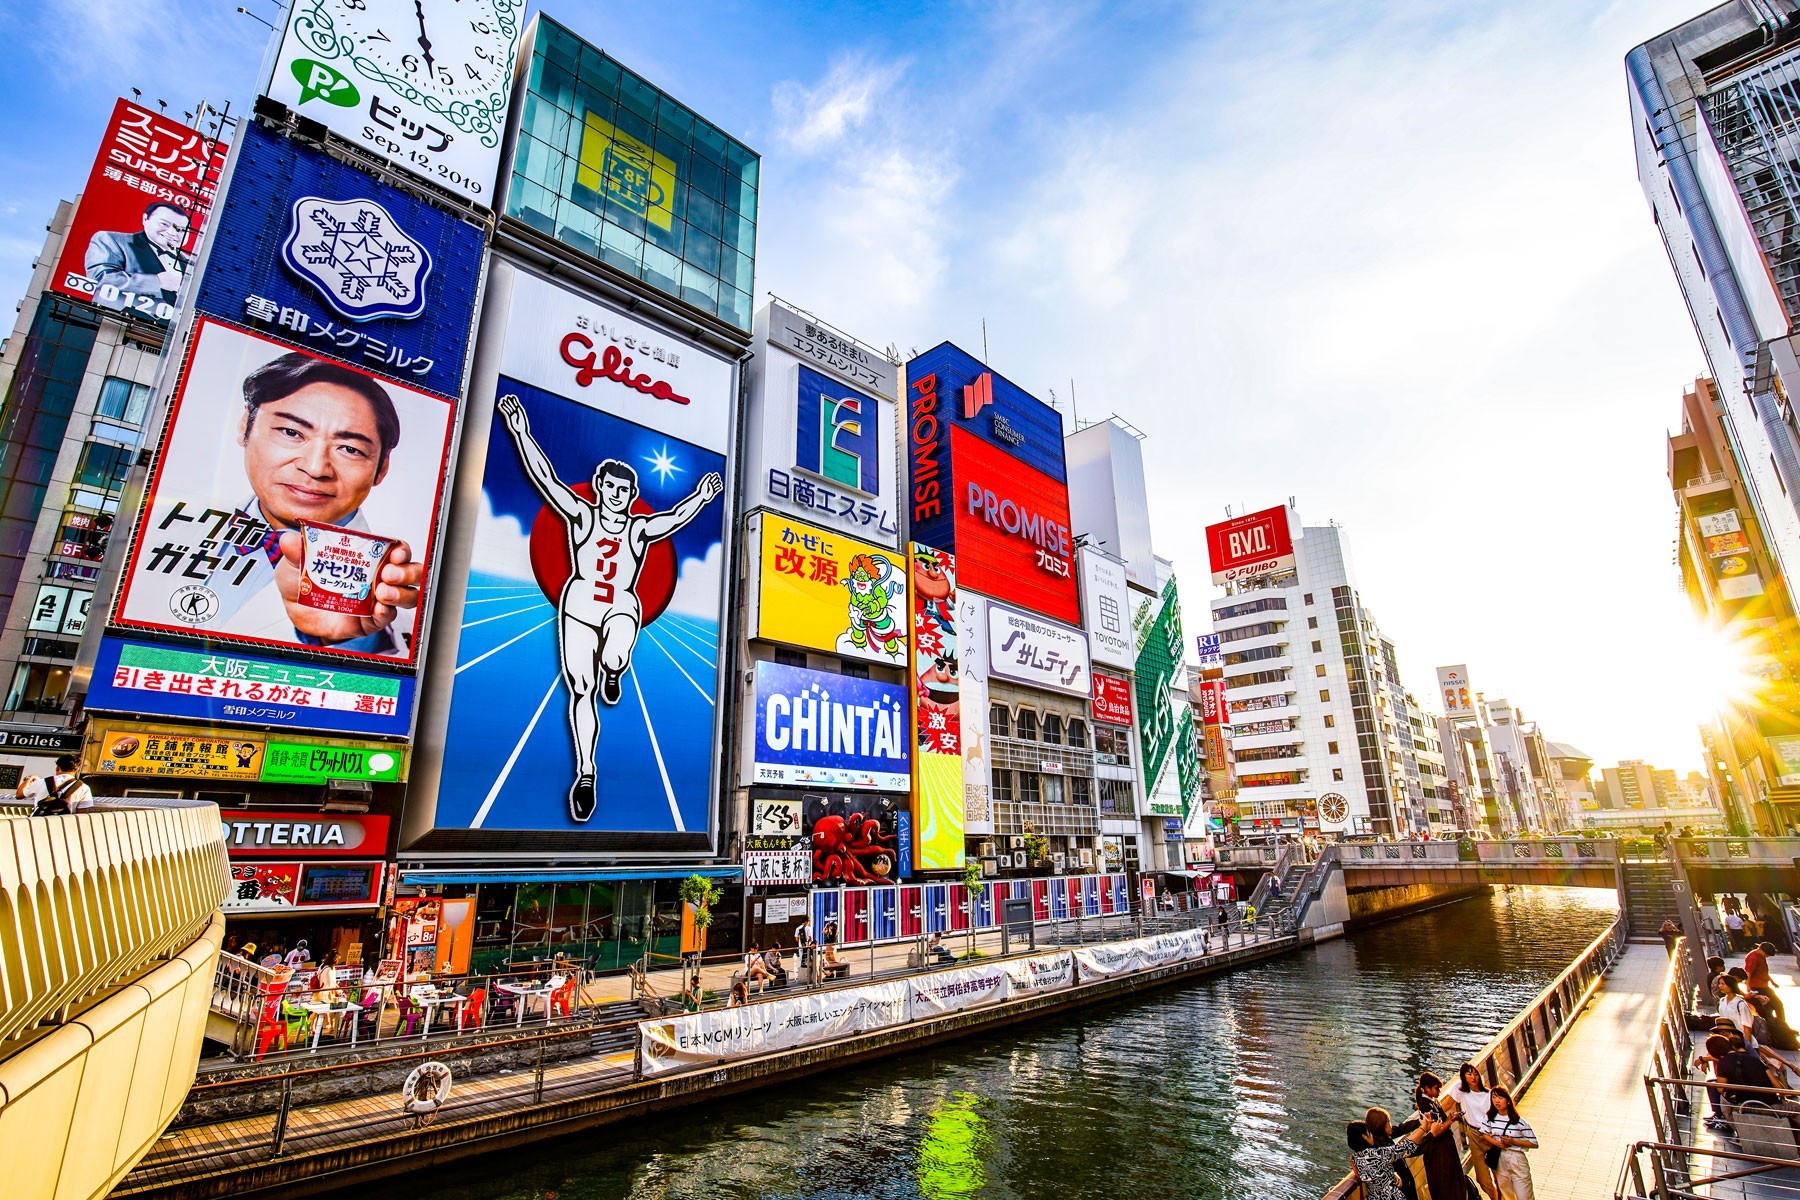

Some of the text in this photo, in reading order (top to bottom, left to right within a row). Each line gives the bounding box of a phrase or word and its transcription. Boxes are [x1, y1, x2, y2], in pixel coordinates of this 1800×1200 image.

[367, 28, 391, 43] 7
[401, 54, 419, 73] 6
[437, 66, 454, 86] 5
[464, 62, 482, 81] 4
[369, 95, 454, 152] ピップ
[109, 148, 184, 187] SUPER
[362, 126, 482, 194] Sep. 12, 2019
[100, 284, 173, 320] 0120
[245, 294, 434, 376] 雪印メグミルク
[804, 323, 869, 365] 夢ある住まい
[560, 332, 691, 406] Glico
[793, 336, 879, 388] エステムシリーズ
[912, 372, 941, 522] PROMISE
[769, 468, 898, 535] 日商エステム
[158, 501, 269, 547] トクホ
[967, 481, 1071, 558] PROMISE
[62, 543, 82, 556] 5F
[782, 527, 834, 557] かぜに
[1229, 526, 1271, 558] B.V.D.
[146, 543, 258, 586] ガセリ
[312, 558, 355, 579] ガセリ
[593, 537, 622, 604] グリコ
[774, 545, 839, 587] 改源
[1035, 549, 1071, 579] プロミス
[1238, 560, 1278, 576] FUJIBO
[199, 655, 335, 689] 大阪ニュース
[1015, 643, 1069, 675] サムティ
[223, 704, 297, 721] 雪印メグミルク
[354, 694, 397, 716] 還付
[766, 683, 902, 760] CHINTAI
[11, 733, 62, 748] Toilets
[145, 740, 229, 755] 店舗情報館
[310, 750, 363, 774] ピタットハウス
[748, 856, 803, 879] 大阪に乾杯
